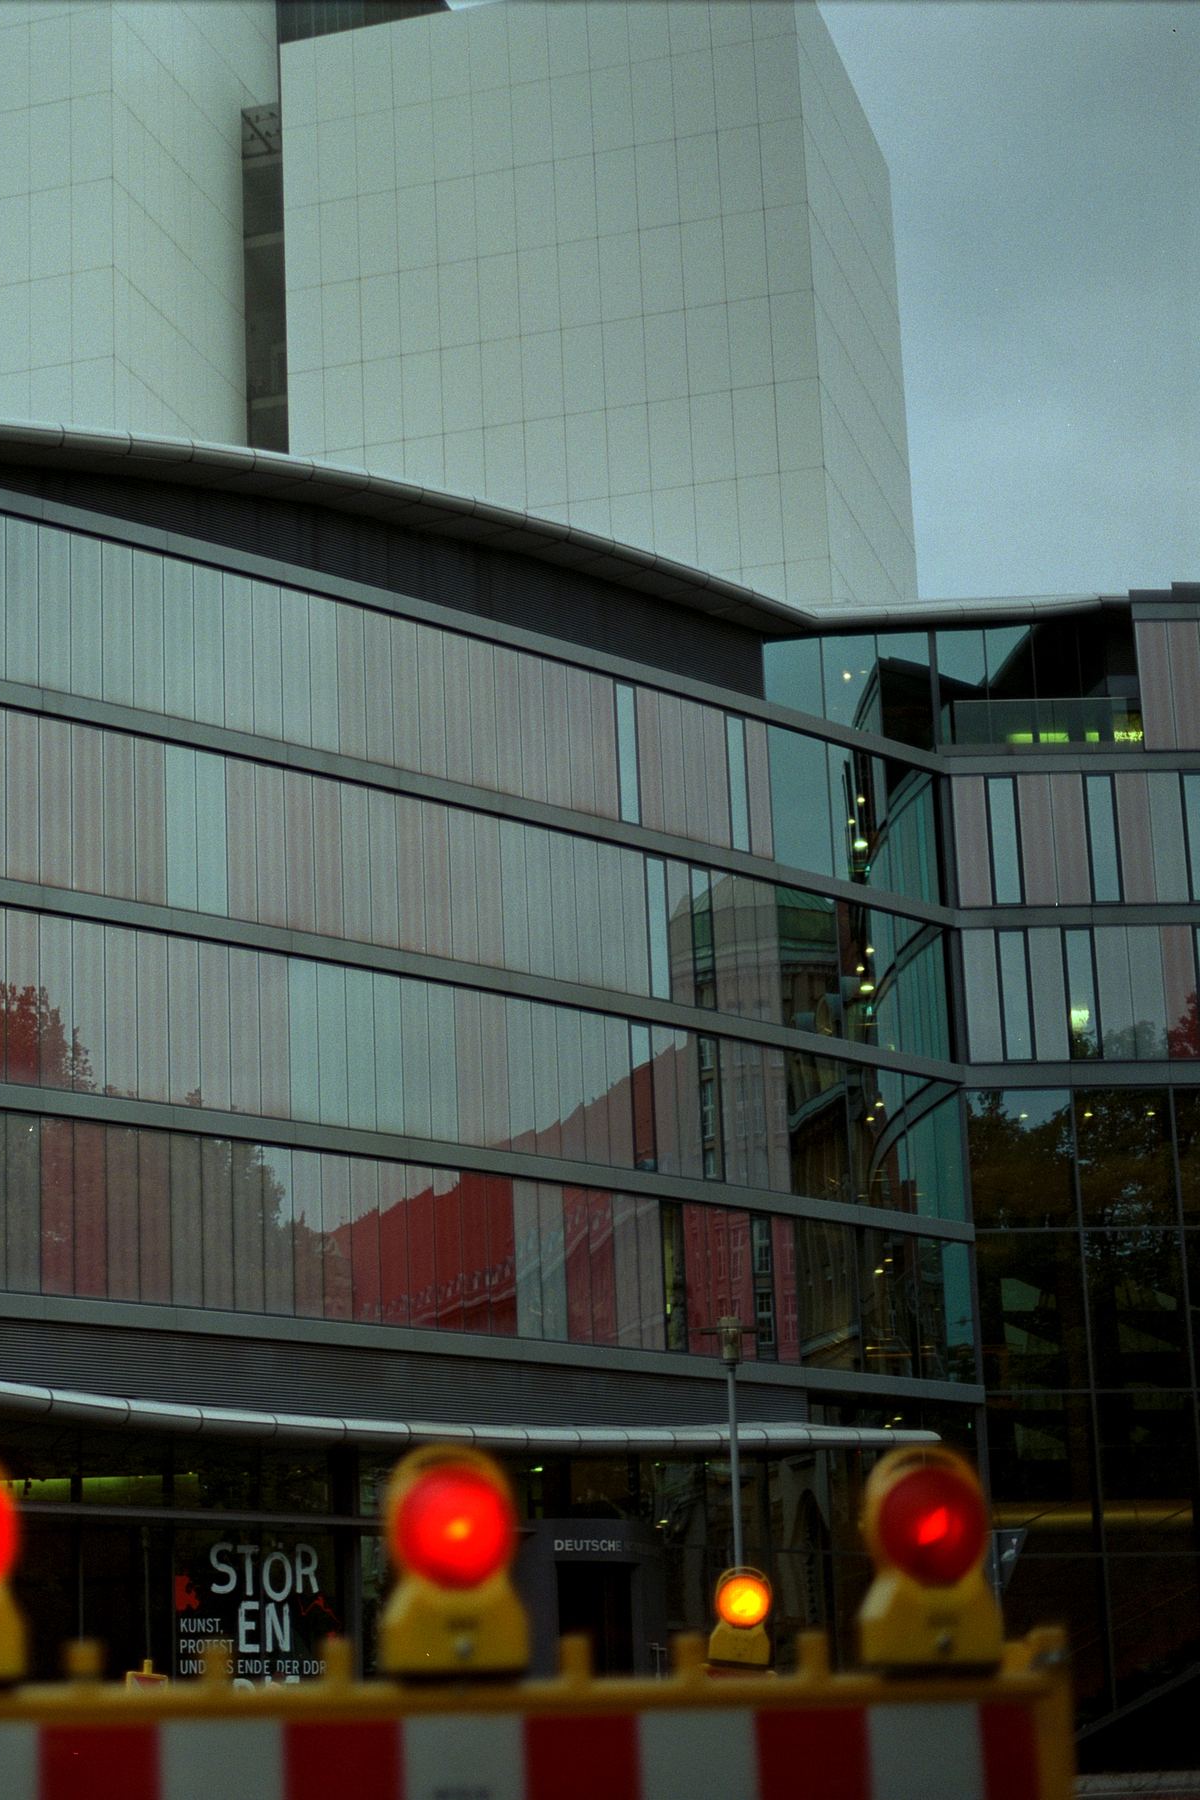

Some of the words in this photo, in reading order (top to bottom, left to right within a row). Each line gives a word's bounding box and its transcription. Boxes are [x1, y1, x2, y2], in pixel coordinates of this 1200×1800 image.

[554, 1539, 622, 1551] DEUTSCHE
[210, 1539, 319, 1602] STÖR
[180, 1618, 224, 1634] KUNST,
[238, 1601, 291, 1653] EN
[180, 1660, 207, 1674] UND
[238, 1659, 271, 1674] ENDE
[277, 1660, 300, 1674] DER
[303, 1660, 327, 1674] DDR
